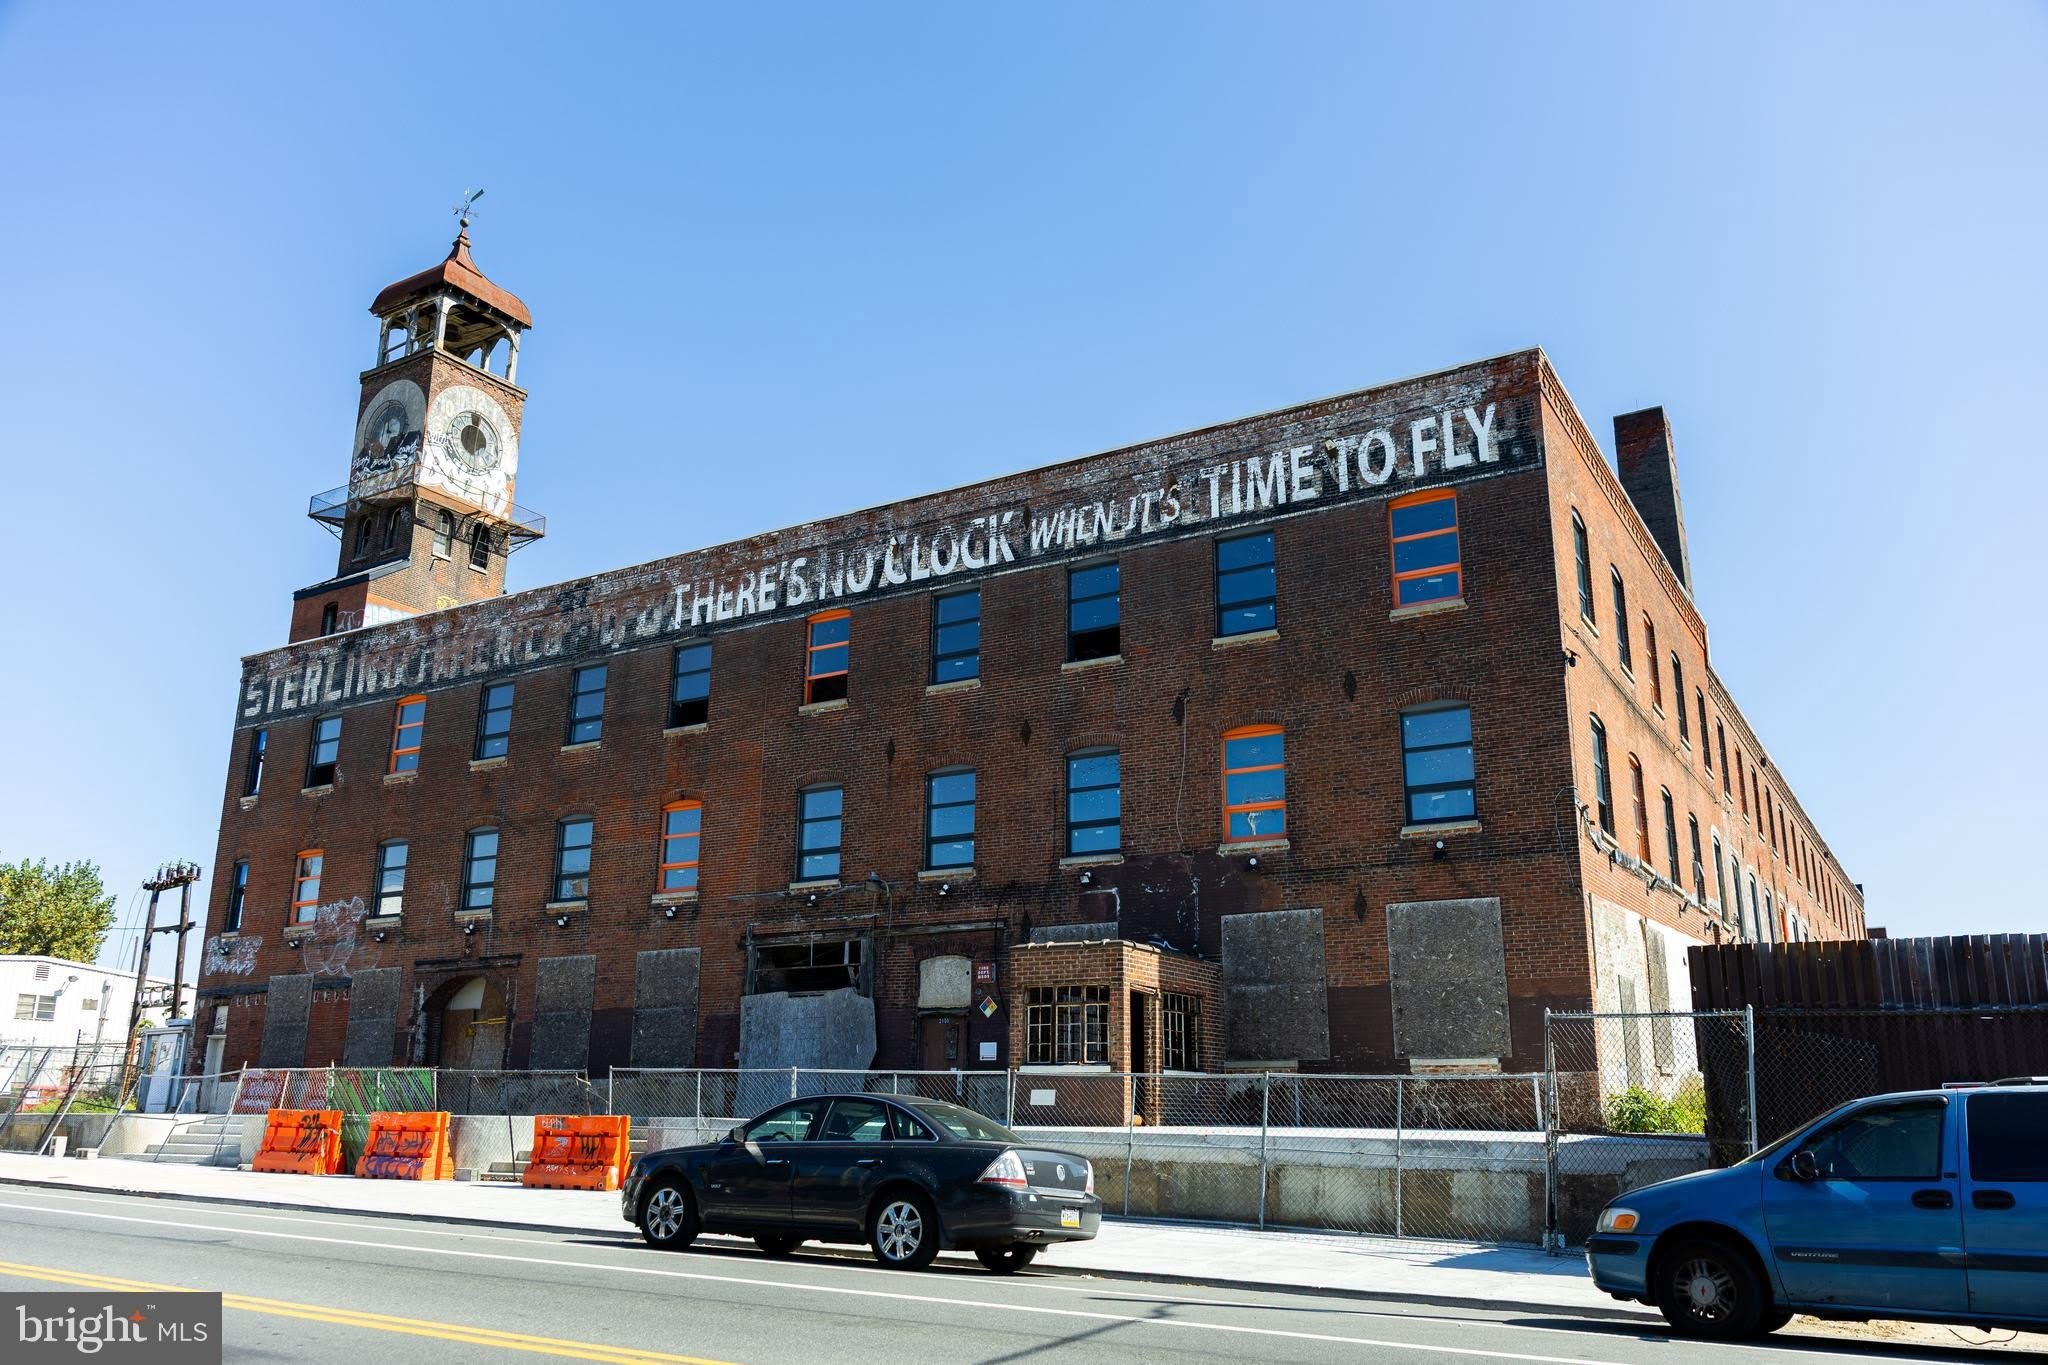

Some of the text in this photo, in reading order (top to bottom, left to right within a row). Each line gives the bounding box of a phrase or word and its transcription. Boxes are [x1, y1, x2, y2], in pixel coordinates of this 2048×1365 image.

[674, 557, 807, 630] THERE'S
[818, 547, 874, 600] NO
[883, 511, 1015, 585] CLOCK
[1030, 500, 1115, 553] WHEN
[1124, 484, 1181, 533] IT'S
[1200, 444, 1318, 519] TIME
[1332, 427, 1396, 492] TO
